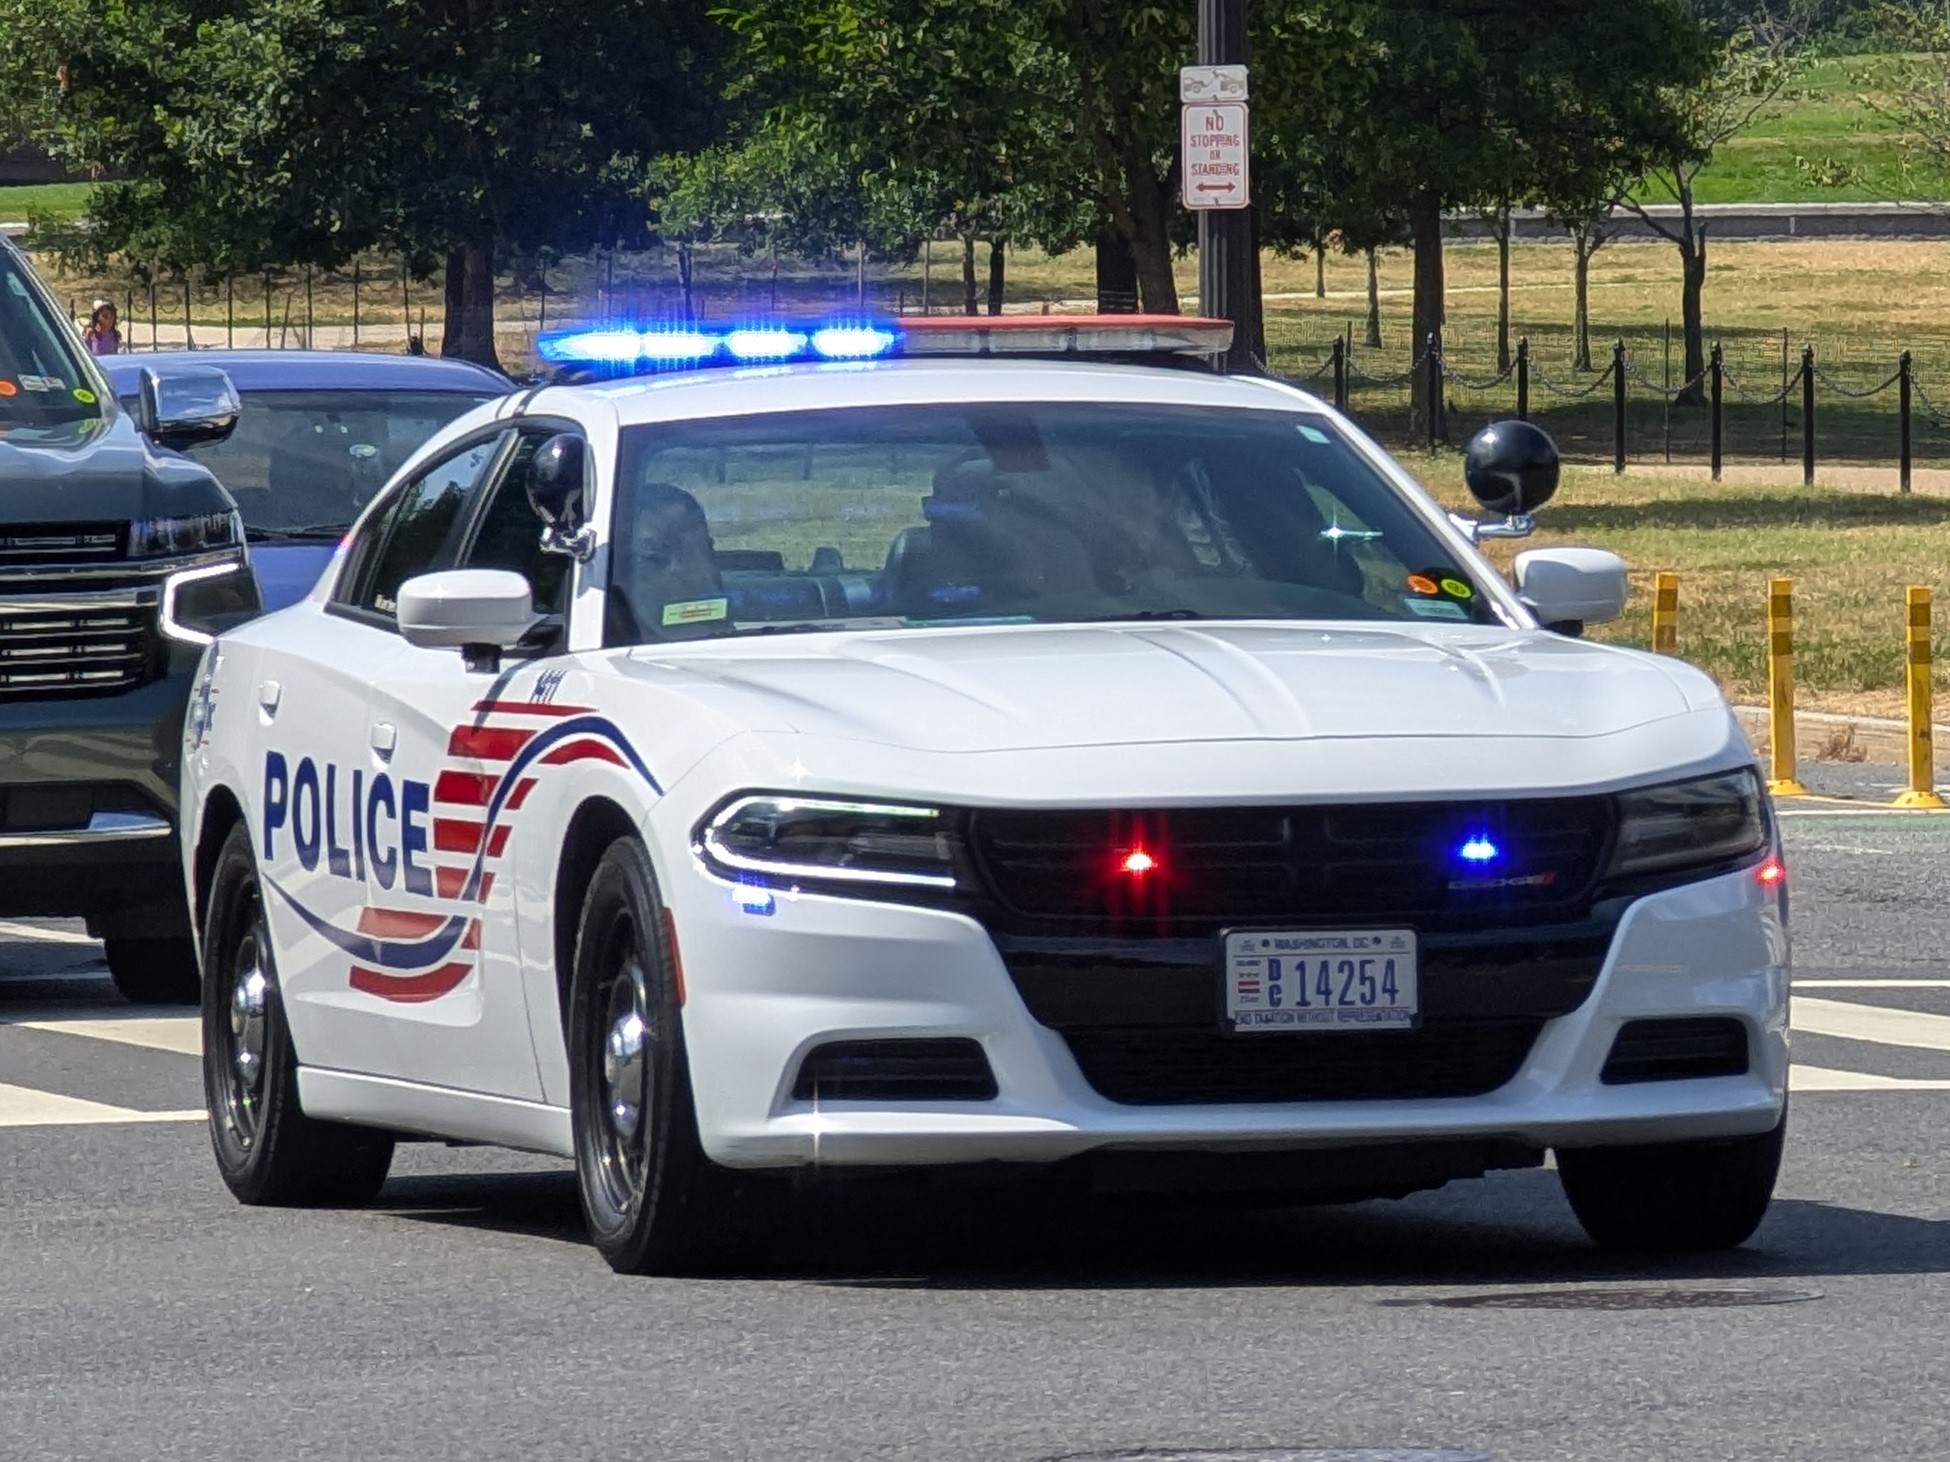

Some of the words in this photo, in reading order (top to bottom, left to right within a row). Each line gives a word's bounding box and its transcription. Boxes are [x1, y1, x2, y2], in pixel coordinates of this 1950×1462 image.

[1206, 116, 1225, 131] NO
[1190, 133, 1240, 148] STOPPING
[1209, 149, 1221, 160] OR
[1191, 163, 1240, 176] STANDING
[264, 750, 434, 897] POLICE
[1295, 958, 1399, 1006] 14254
